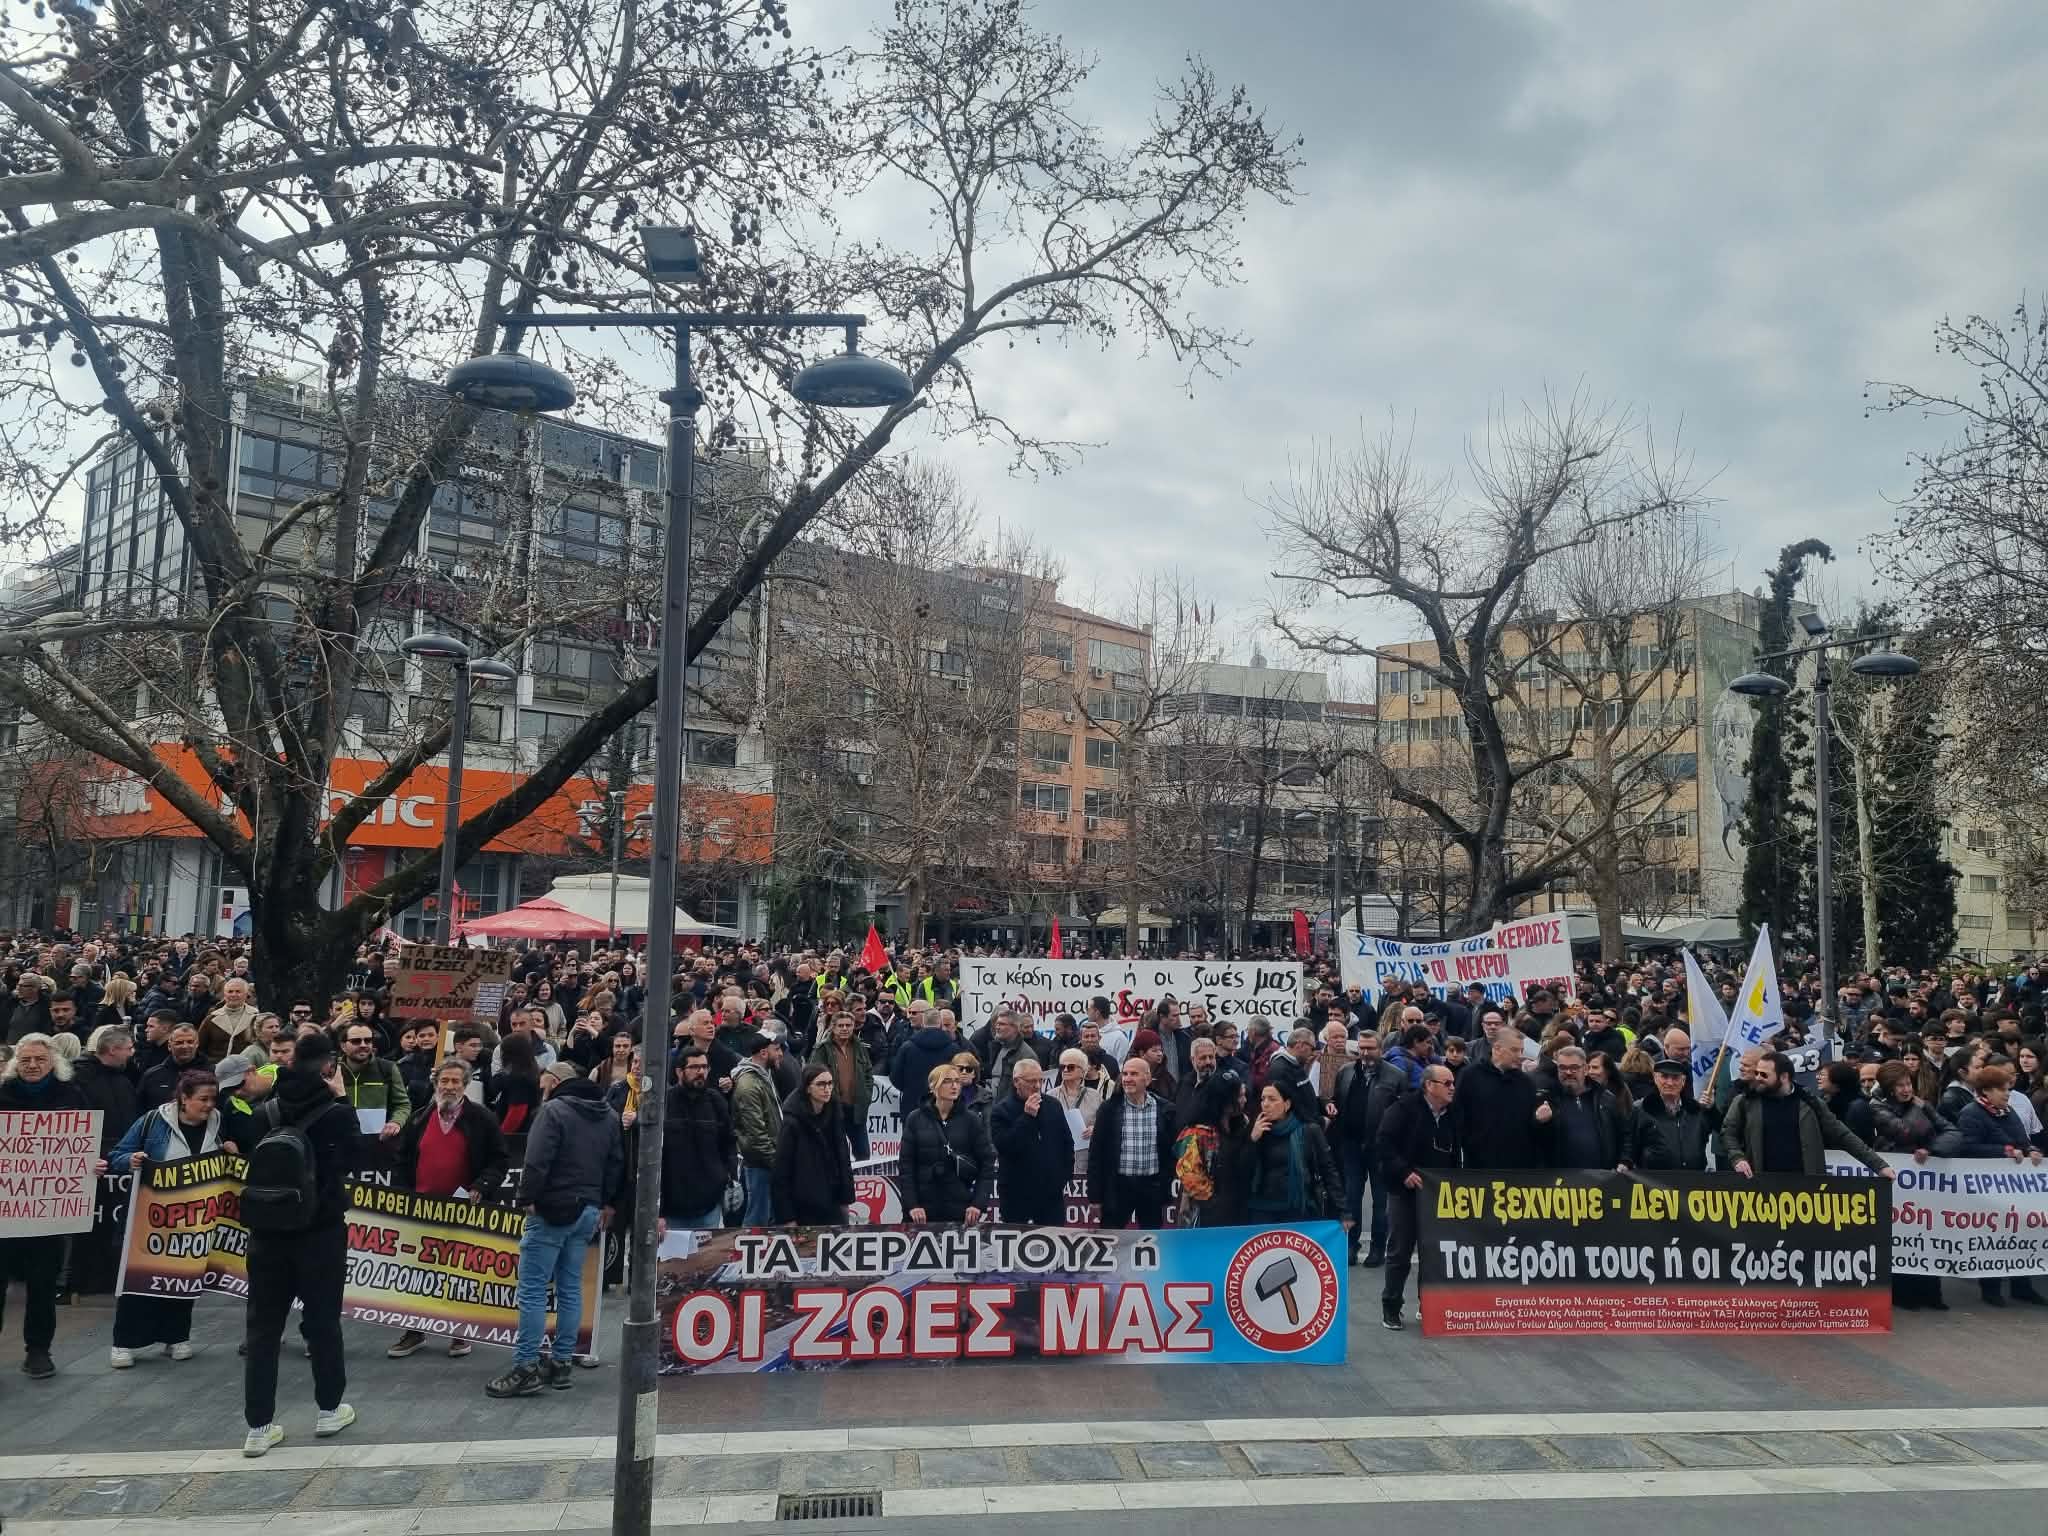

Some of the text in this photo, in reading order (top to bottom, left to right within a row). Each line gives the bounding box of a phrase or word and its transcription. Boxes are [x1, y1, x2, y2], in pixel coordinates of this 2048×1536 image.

[1496, 919, 1563, 950] ΚΕΡΔΟΥΣ
[970, 963, 1299, 997] Τα κέρδη τους ή οι ζωές μας
[1430, 960, 1449, 984] ΟΙ
[1455, 953, 1511, 982] ΝΕΚΡΟΙ
[969, 991, 994, 1015] Το
[1204, 994, 1298, 1022] ξεχαστεί
[0, 1111, 92, 1136] ΤΕΜΠΗ
[868, 1115, 889, 1134] ΣΤΑ
[0, 1136, 97, 1155] ΧΙΟΣ-ΠΥΛΟΣ
[0, 1157, 88, 1176] ΒΙΟΛΑΝΤΑ
[0, 1176, 85, 1197] ΜΑΓΓΟΣ
[152, 1166, 178, 1188] ΑΝ
[352, 1185, 373, 1210] ΘΑ
[376, 1190, 410, 1215] ΡΘΕΙ
[412, 1197, 486, 1230] ΑΝΑΠΟΔΑ
[488, 1210, 500, 1231] Ο
[0, 1196, 92, 1218] ΑΛΑΙΣΤΙΝΗ
[1436, 1180, 1486, 1220] Δεν
[1491, 1178, 1604, 1227] ξεχνάμε
[1630, 1183, 1680, 1220] Δεν
[1687, 1183, 1877, 1232] συγχωρούμε!
[1940, 1209, 1999, 1233] τους
[2005, 1204, 2020, 1234] ή
[347, 1222, 400, 1257] ΝΑΣ
[737, 1231, 1160, 1277] ΤΑ ΚΕΡΔΗ ΤΟΥΣ ή
[1284, 1234, 1328, 1272] ΚΕΝΤΡΟ
[1929, 1237, 1964, 1255] της
[1968, 1235, 2039, 1254] Ελλάδας
[147, 1232, 164, 1255] Ο
[356, 1257, 374, 1286] Ο
[371, 1262, 449, 1298] ΔΡΟΜΟΣ
[447, 1276, 481, 1304] ΤΗΣ
[1439, 1236, 1877, 1289] Τα κέρδη τους ή οι ζωές μας!
[1933, 1253, 2046, 1275] σχεδιασμούς
[1301, 1291, 1335, 1343] ΛΑΡΙΣΑΣ
[1445, 1309, 1516, 1319] Φαρμακευτικός
[1517, 1308, 1562, 1319] Σύλλογος
[1563, 1308, 1604, 1319] Λάρισας
[1611, 1309, 1656, 1319] Σωματείο
[1658, 1308, 1711, 1320] Ιδιοκτητών
[1713, 1309, 1736, 1319] ΤΑΞΙ
[1737, 1309, 1778, 1320] Λάρισας
[1495, 1297, 1537, 1308] Εργατικό
[1538, 1296, 1572, 1308] Κέντρο
[1574, 1297, 1585, 1307] Ν.
[1586, 1297, 1626, 1308] Λάρισας
[1677, 1297, 1730, 1309] Εμπορικός
[1731, 1297, 1778, 1310] Σύλλογος
[1779, 1298, 1820, 1310] Λάρισας
[353, 1306, 462, 1335] ΤΟΥΡΙΣΜΟΥ
[463, 1321, 482, 1340] Ν.
[672, 1283, 1214, 1362] ΟΙ ΖΩΕΣ ΜΑΣ
[1476, 1319, 1515, 1331] Συλλόγων
[1516, 1319, 1548, 1330] Γονέων
[1548, 1319, 1574, 1331] Δήμου
[1575, 1319, 1608, 1331] Λάρισας
[1656, 1319, 1694, 1331] Σύλλογοι
[1700, 1319, 1739, 1331] Σύλλογος
[1850, 1318, 1870, 1329] 2023
